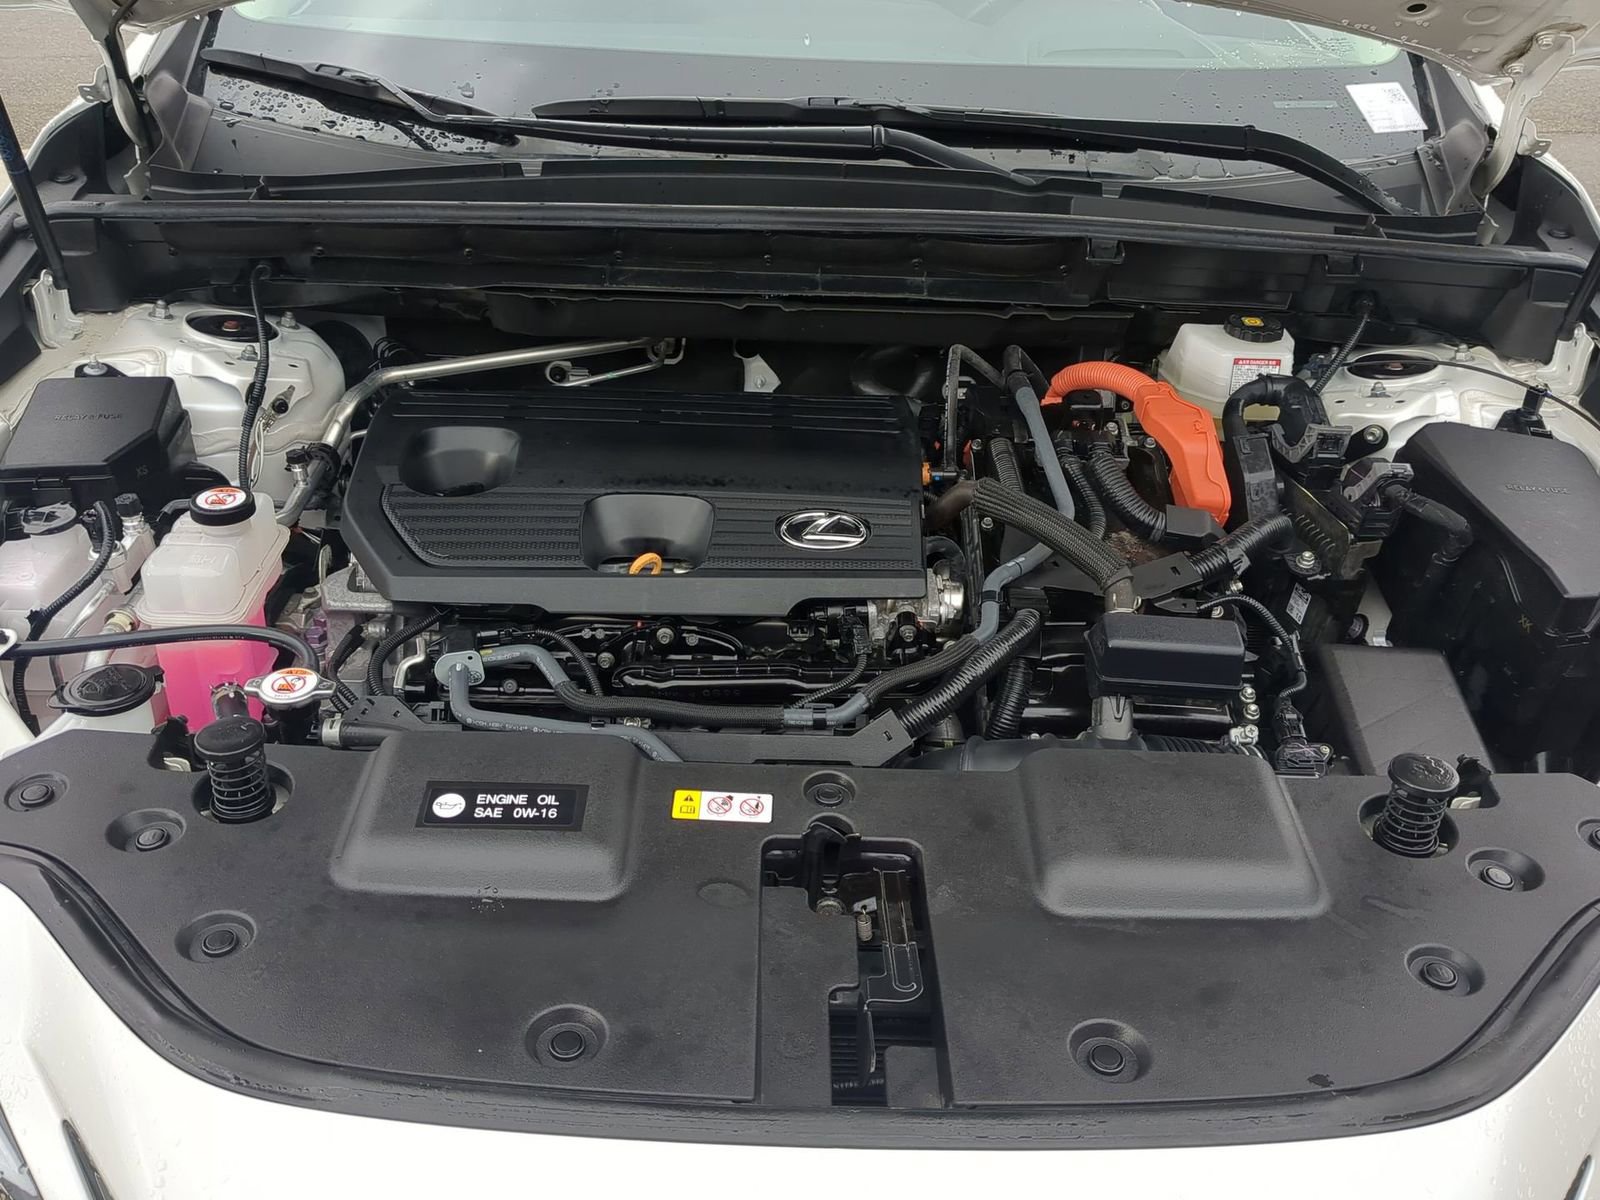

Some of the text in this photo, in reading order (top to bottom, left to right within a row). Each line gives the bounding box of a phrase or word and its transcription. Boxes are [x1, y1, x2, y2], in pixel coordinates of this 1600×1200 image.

[476, 793, 560, 806] ENGINE OIL
[473, 807, 558, 819] SAE 0W-16
